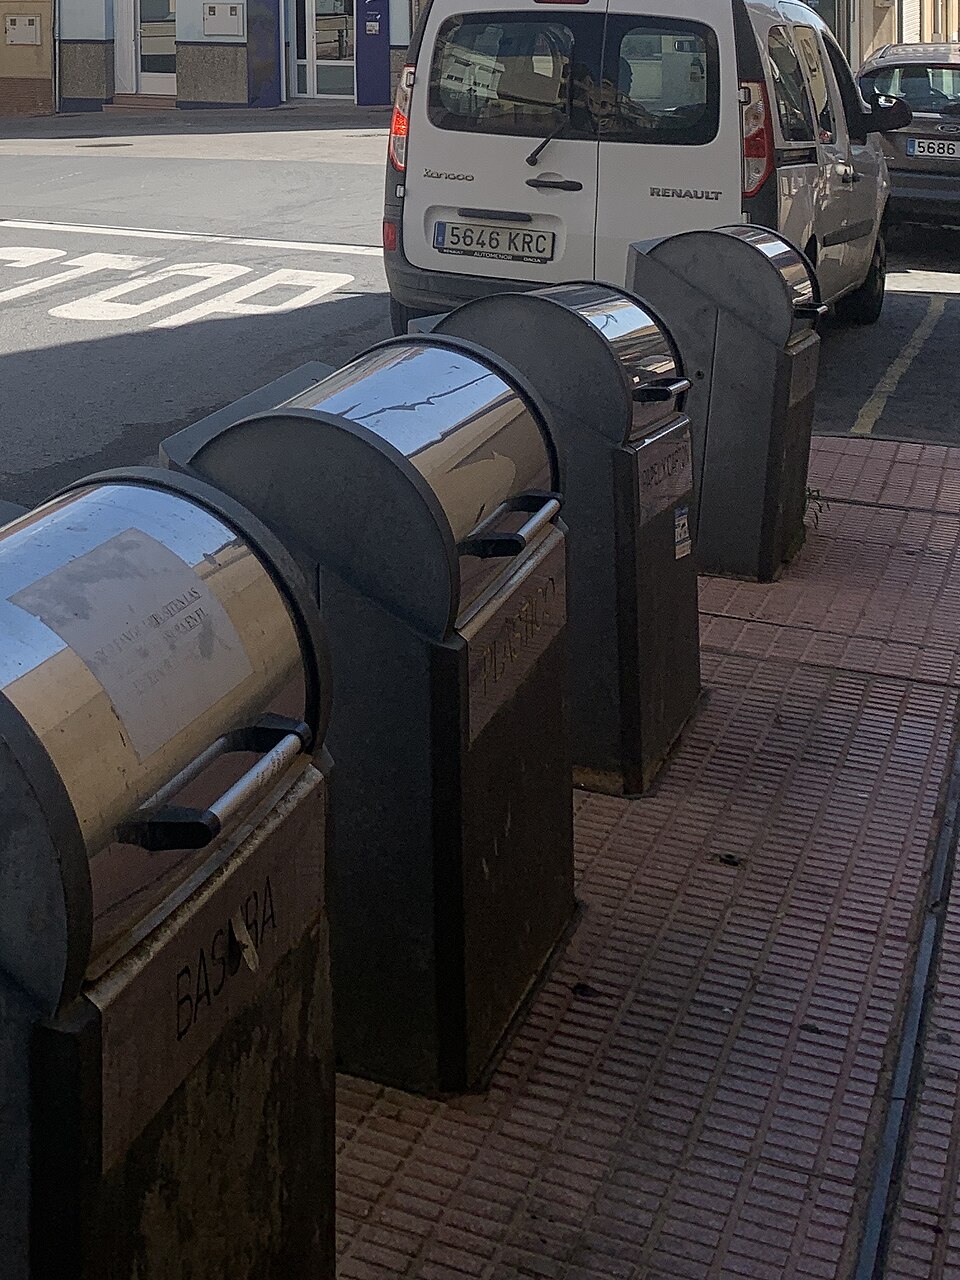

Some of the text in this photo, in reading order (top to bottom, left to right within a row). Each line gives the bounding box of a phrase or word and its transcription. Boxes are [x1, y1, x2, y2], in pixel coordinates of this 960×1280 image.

[917, 141, 956, 155] 5686
[649, 186, 723, 201] RENAULT
[449, 226, 547, 254] 5646 KRC
[473, 251, 513, 260] AUTOMENOR
